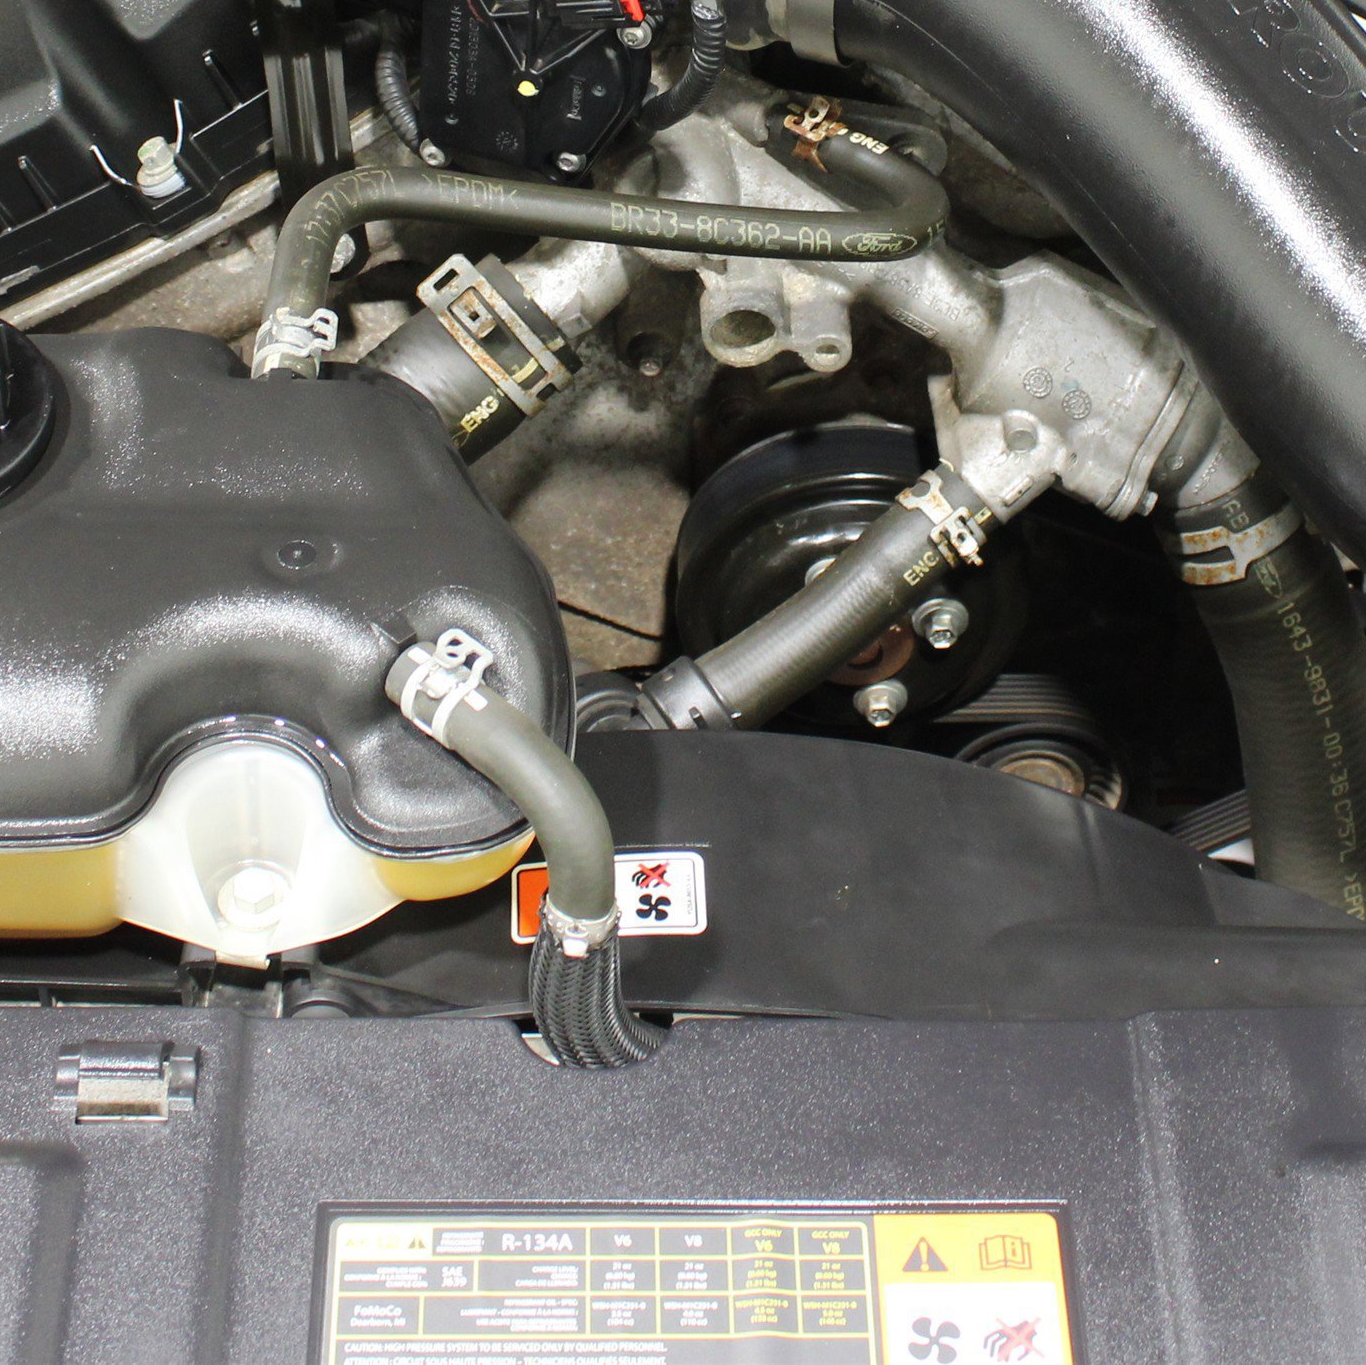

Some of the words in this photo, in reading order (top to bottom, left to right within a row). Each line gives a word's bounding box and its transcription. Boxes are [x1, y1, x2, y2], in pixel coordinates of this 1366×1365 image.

[849, 131, 890, 155] ENG
[609, 201, 833, 254] BR33-8C362-AA
[460, 395, 500, 433] ENG
[744, 1229, 759, 1238] GCC
[760, 1229, 782, 1238] ONLY
[811, 1230, 827, 1240] GCC
[828, 1230, 849, 1239] ONLY
[501, 1233, 573, 1252] R-134A
[613, 1235, 632, 1247] V6
[684, 1235, 703, 1247] V8
[754, 1239, 773, 1252] V6
[821, 1242, 841, 1254] V8
[441, 1266, 463, 1276] SAE
[353, 1305, 402, 1316] FoMoCo
[350, 1317, 393, 1327] Dearborn,
[344, 1342, 383, 1353] CAUTION:
[384, 1342, 405, 1353] HIGH
[406, 1342, 445, 1353] PRESSURE
[446, 1342, 478, 1353] SYSTEM
[479, 1342, 490, 1353] TO
[492, 1342, 502, 1353] BE
[503, 1342, 540, 1353] SERVICED
[541, 1342, 563, 1353] ONLY
[563, 1342, 574, 1353] BY
[575, 1342, 618, 1353] QUALIFIED
[618, 1342, 667, 1353] PERSONNEL.
